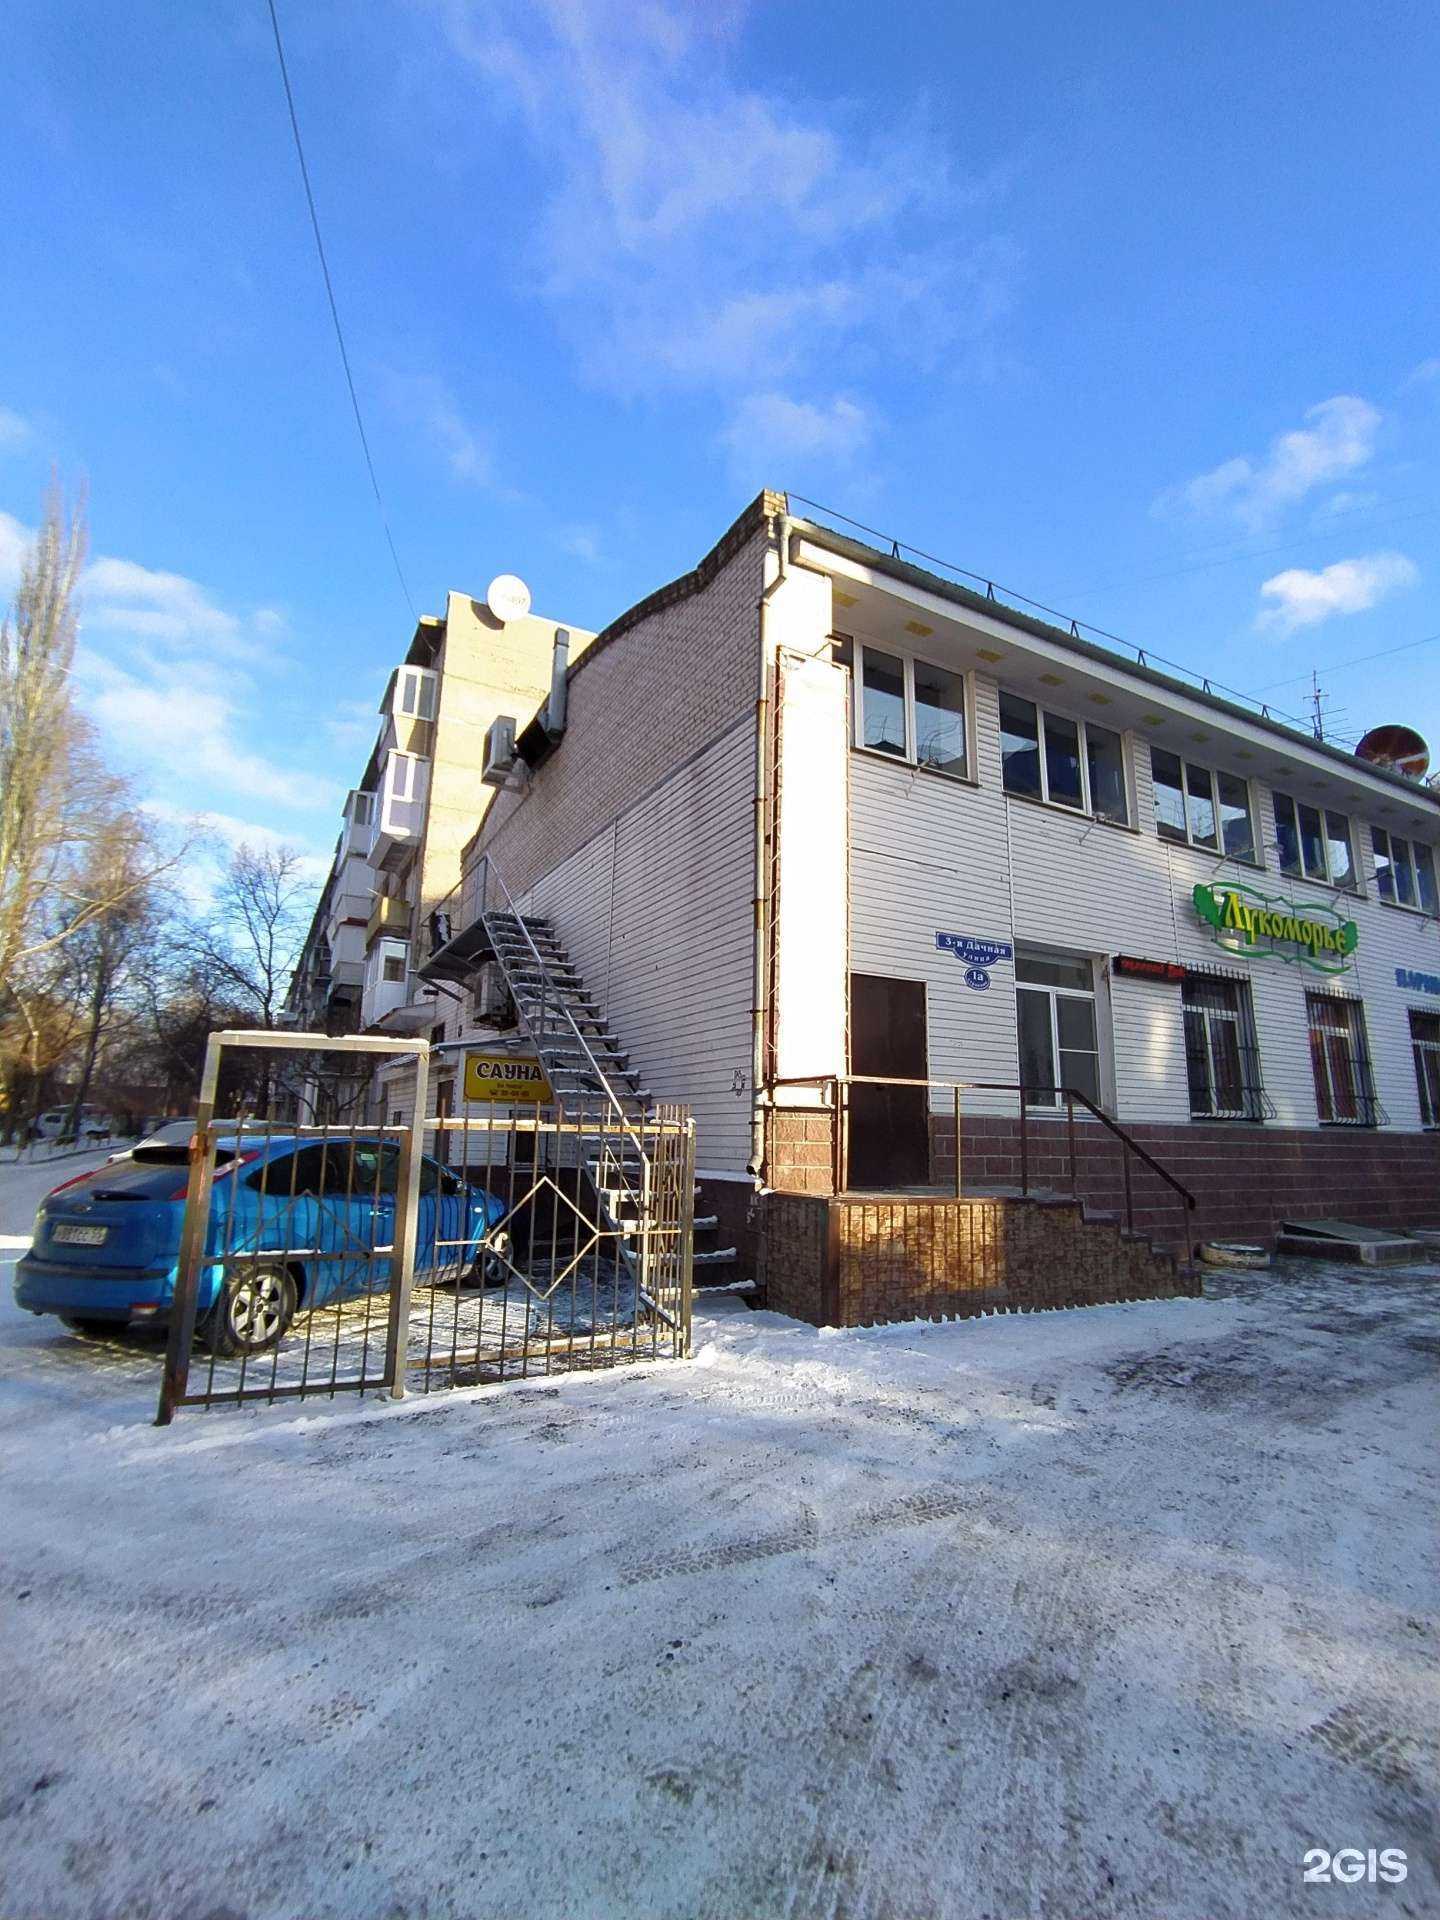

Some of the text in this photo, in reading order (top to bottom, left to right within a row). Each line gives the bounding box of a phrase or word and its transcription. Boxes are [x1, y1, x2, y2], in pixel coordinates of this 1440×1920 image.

[1221, 891, 1346, 957] Лукоморье
[945, 937, 1006, 955] 3-я Дачная
[972, 971, 984, 981] 1а
[476, 1062, 543, 1081] САУНА
